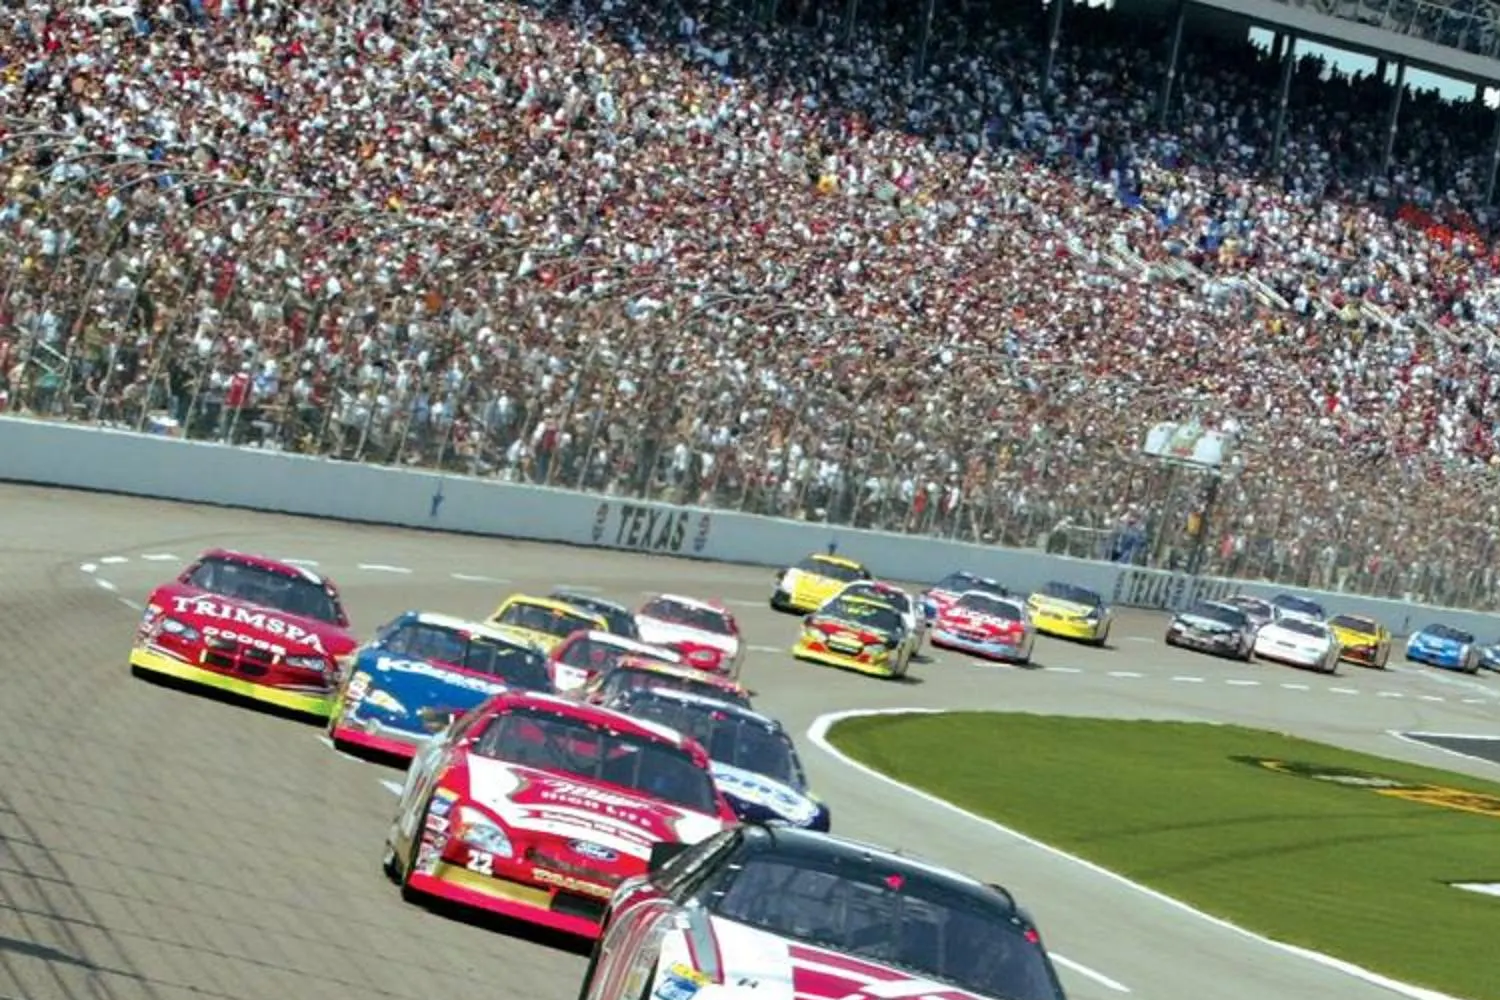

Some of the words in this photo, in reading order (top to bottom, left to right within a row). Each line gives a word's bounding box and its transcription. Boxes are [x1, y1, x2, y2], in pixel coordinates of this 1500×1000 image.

[615, 503, 690, 552] TEXAS
[171, 596, 328, 656] TRIMSPA
[466, 848, 495, 876] 22
